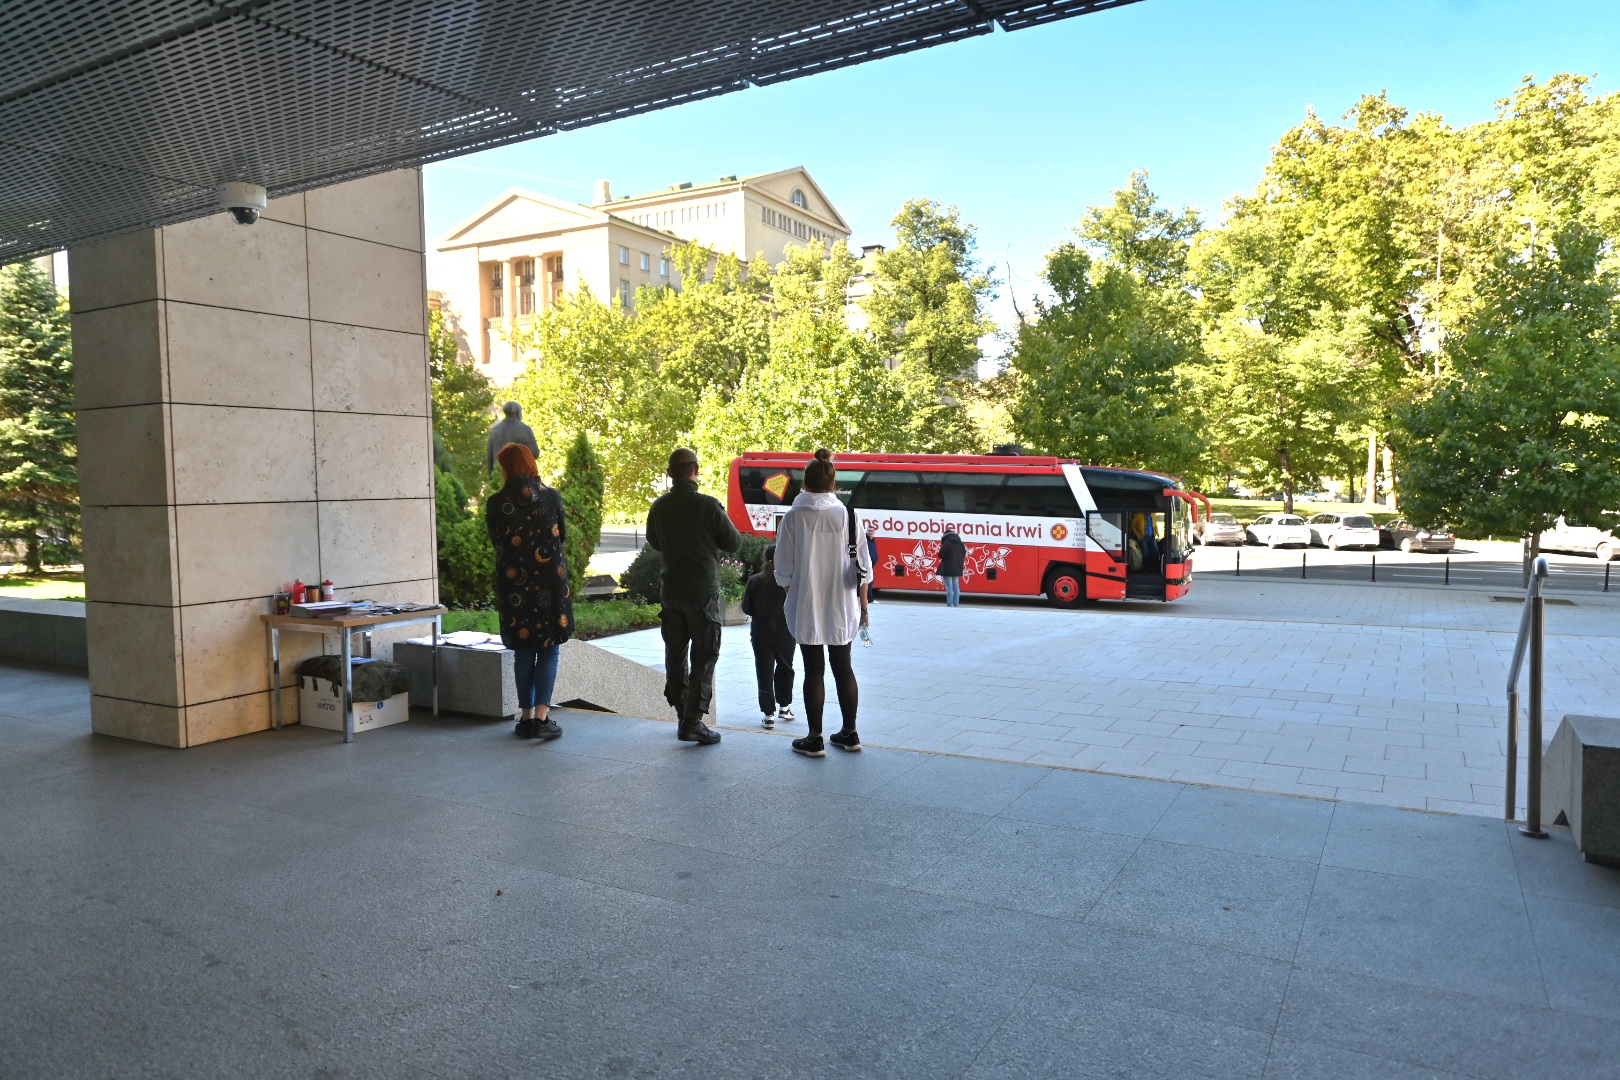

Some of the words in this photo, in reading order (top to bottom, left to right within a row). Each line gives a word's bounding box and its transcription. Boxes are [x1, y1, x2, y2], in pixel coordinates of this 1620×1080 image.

[882, 517, 904, 531] do
[907, 518, 1001, 537] pobierania
[1005, 521, 1042, 539] krwi
